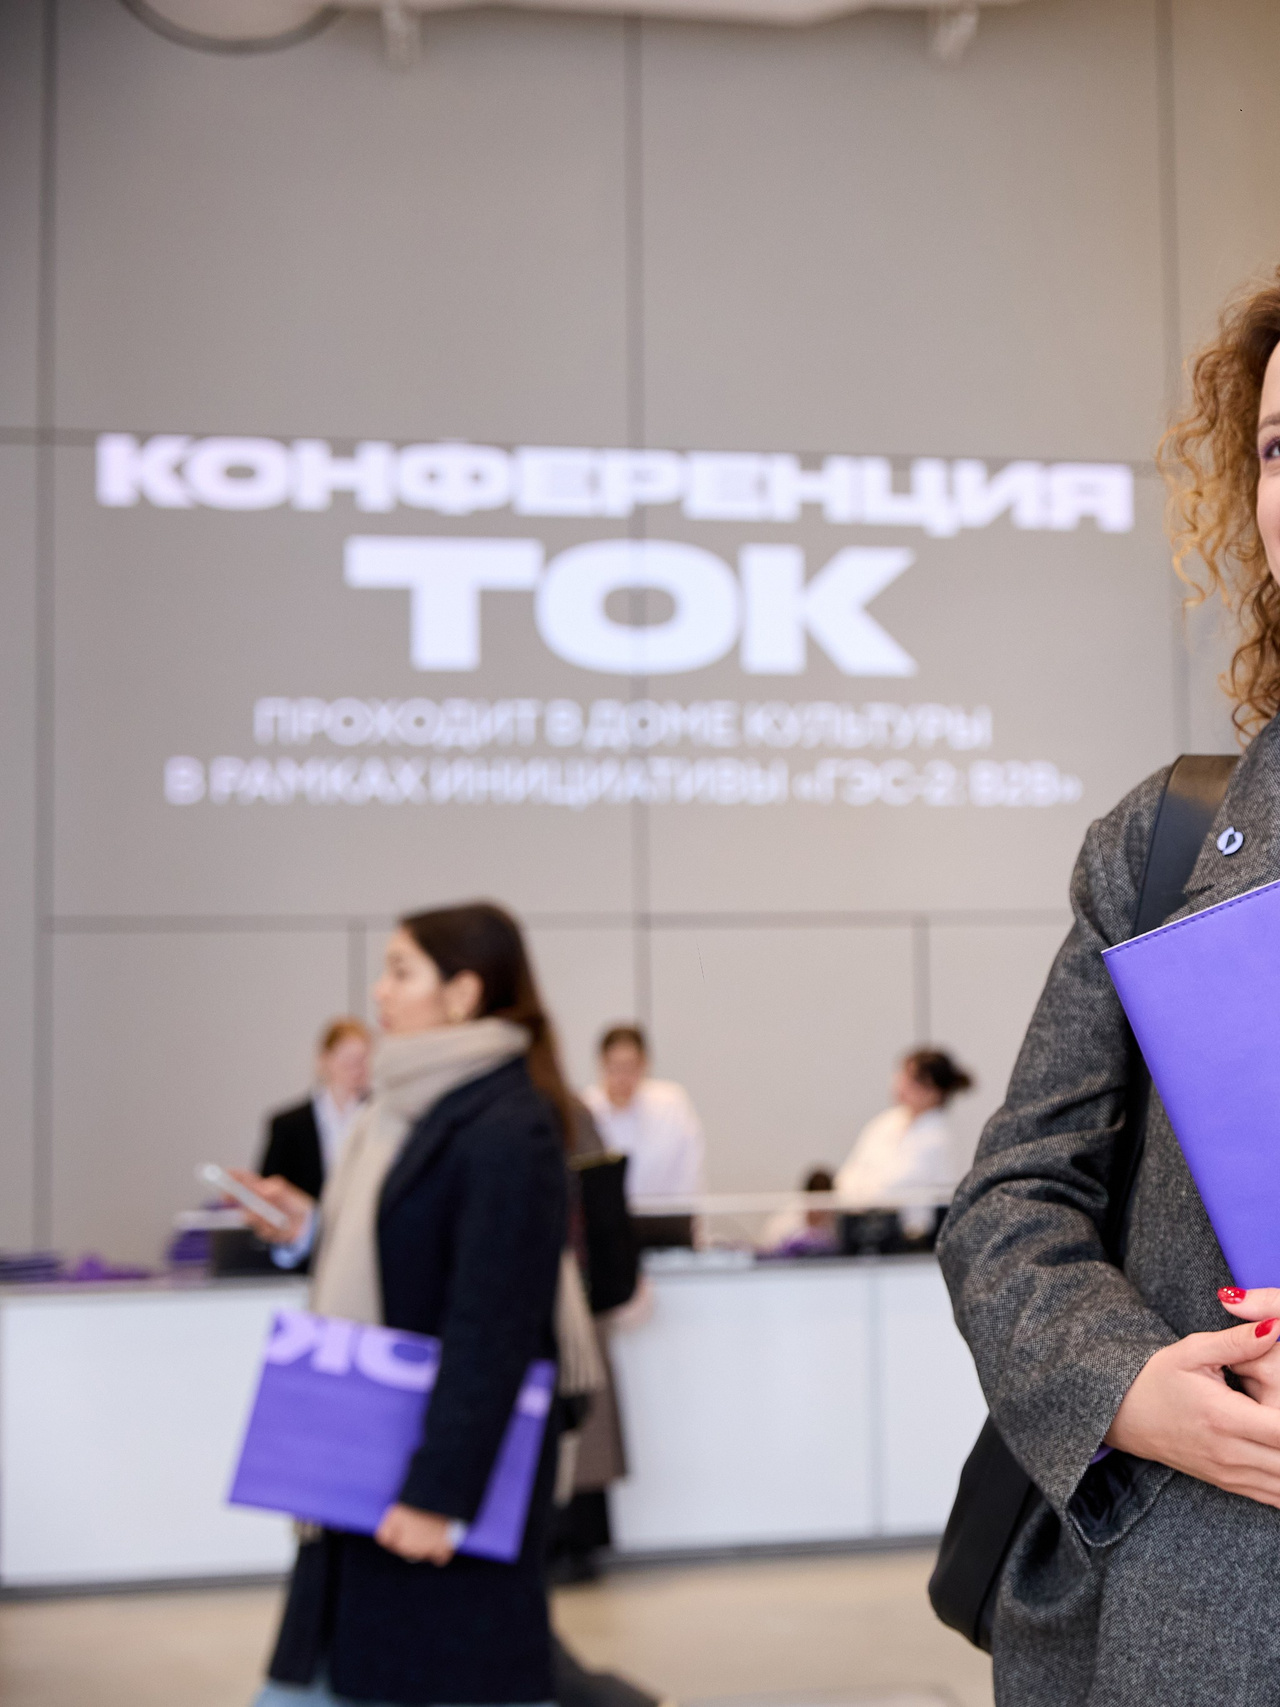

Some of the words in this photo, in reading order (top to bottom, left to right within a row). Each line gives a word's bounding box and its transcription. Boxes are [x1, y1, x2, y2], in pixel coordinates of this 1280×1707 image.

[97, 434, 1134, 538] КОНФЕРЕНЦИЯ
[344, 536, 916, 677] ТОК
[255, 699, 540, 750] ПРОХОДИТ
[546, 701, 583, 747] В
[586, 701, 738, 751] ДОМЕ
[745, 703, 991, 750] КУЛЬТУРЫ
[165, 758, 203, 803] В
[212, 758, 426, 802] РАМКАХ
[431, 758, 787, 811] ИНИЦИАТИВЫ
